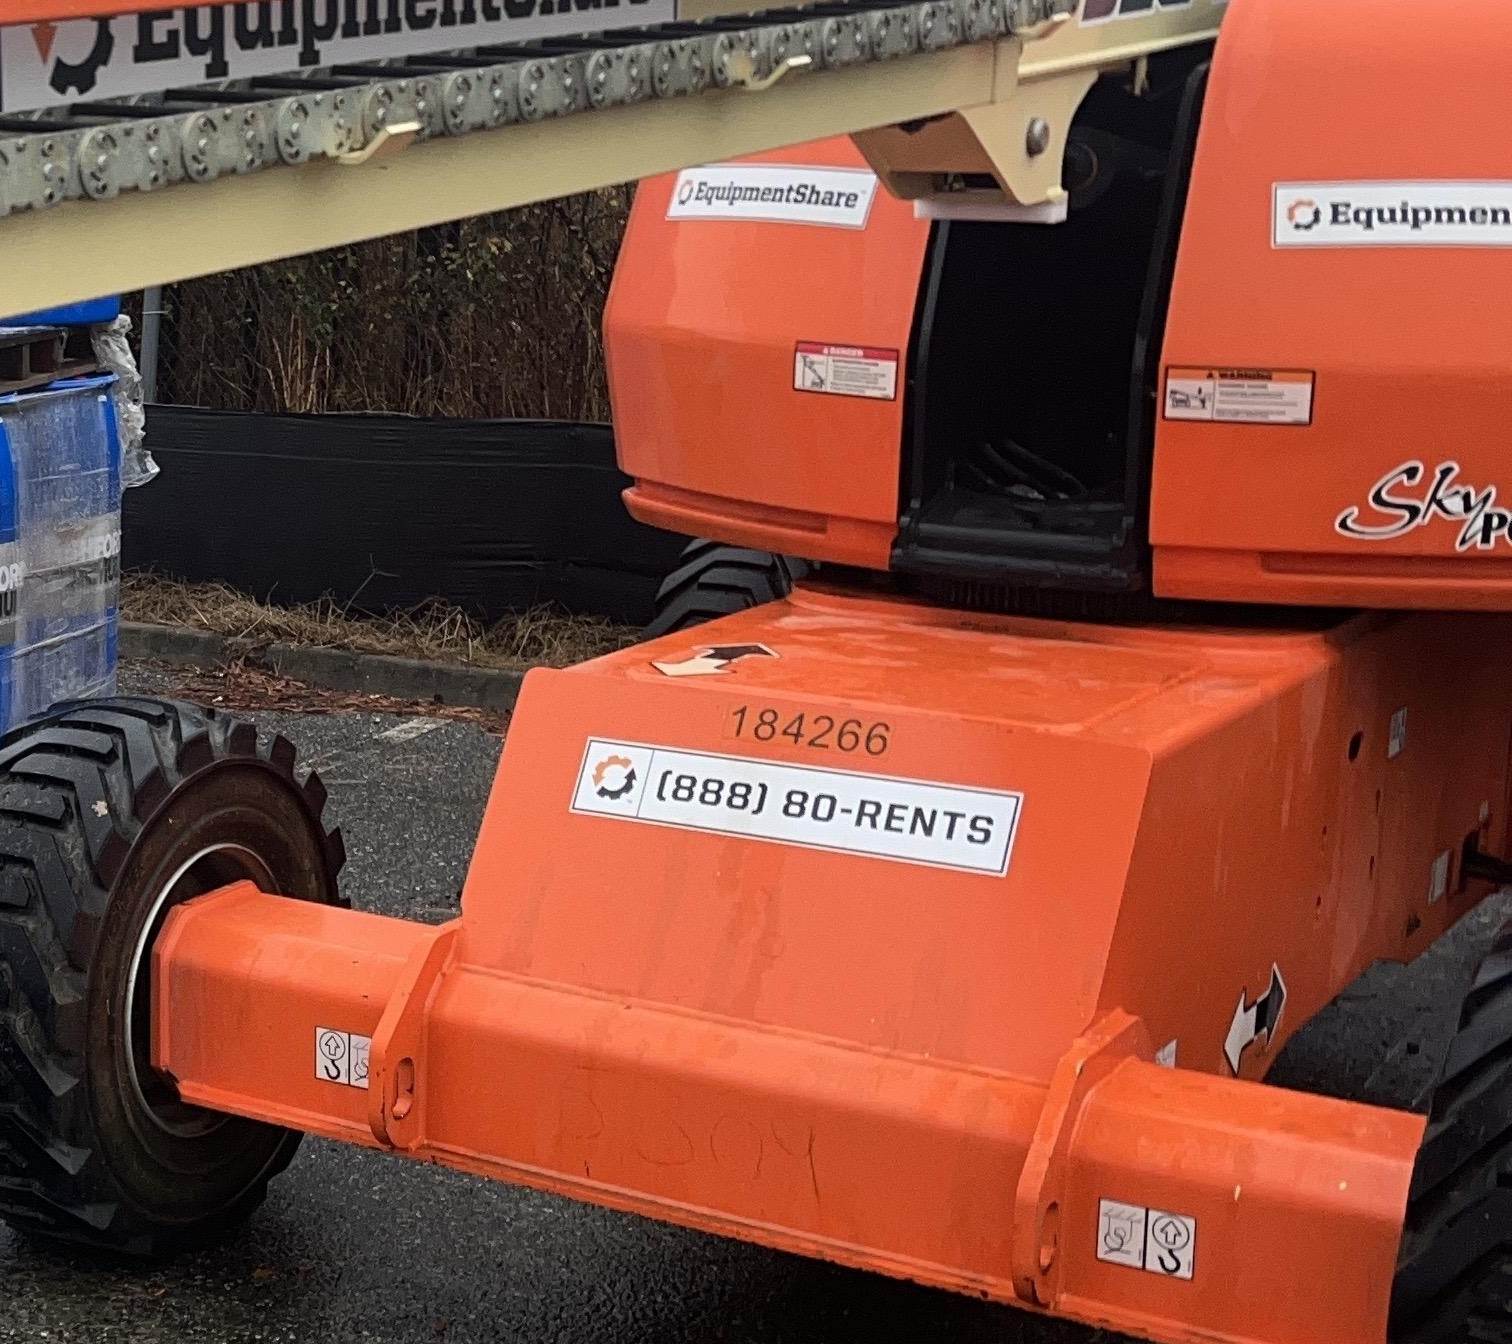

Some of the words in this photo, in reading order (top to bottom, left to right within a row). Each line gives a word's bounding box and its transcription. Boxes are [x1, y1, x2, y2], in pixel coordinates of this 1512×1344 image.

[694, 181, 859, 209] EquipmentShare
[731, 705, 892, 756] 184266
[656, 770, 768, 815] (888)
[782, 791, 996, 846] 80-RENTS
